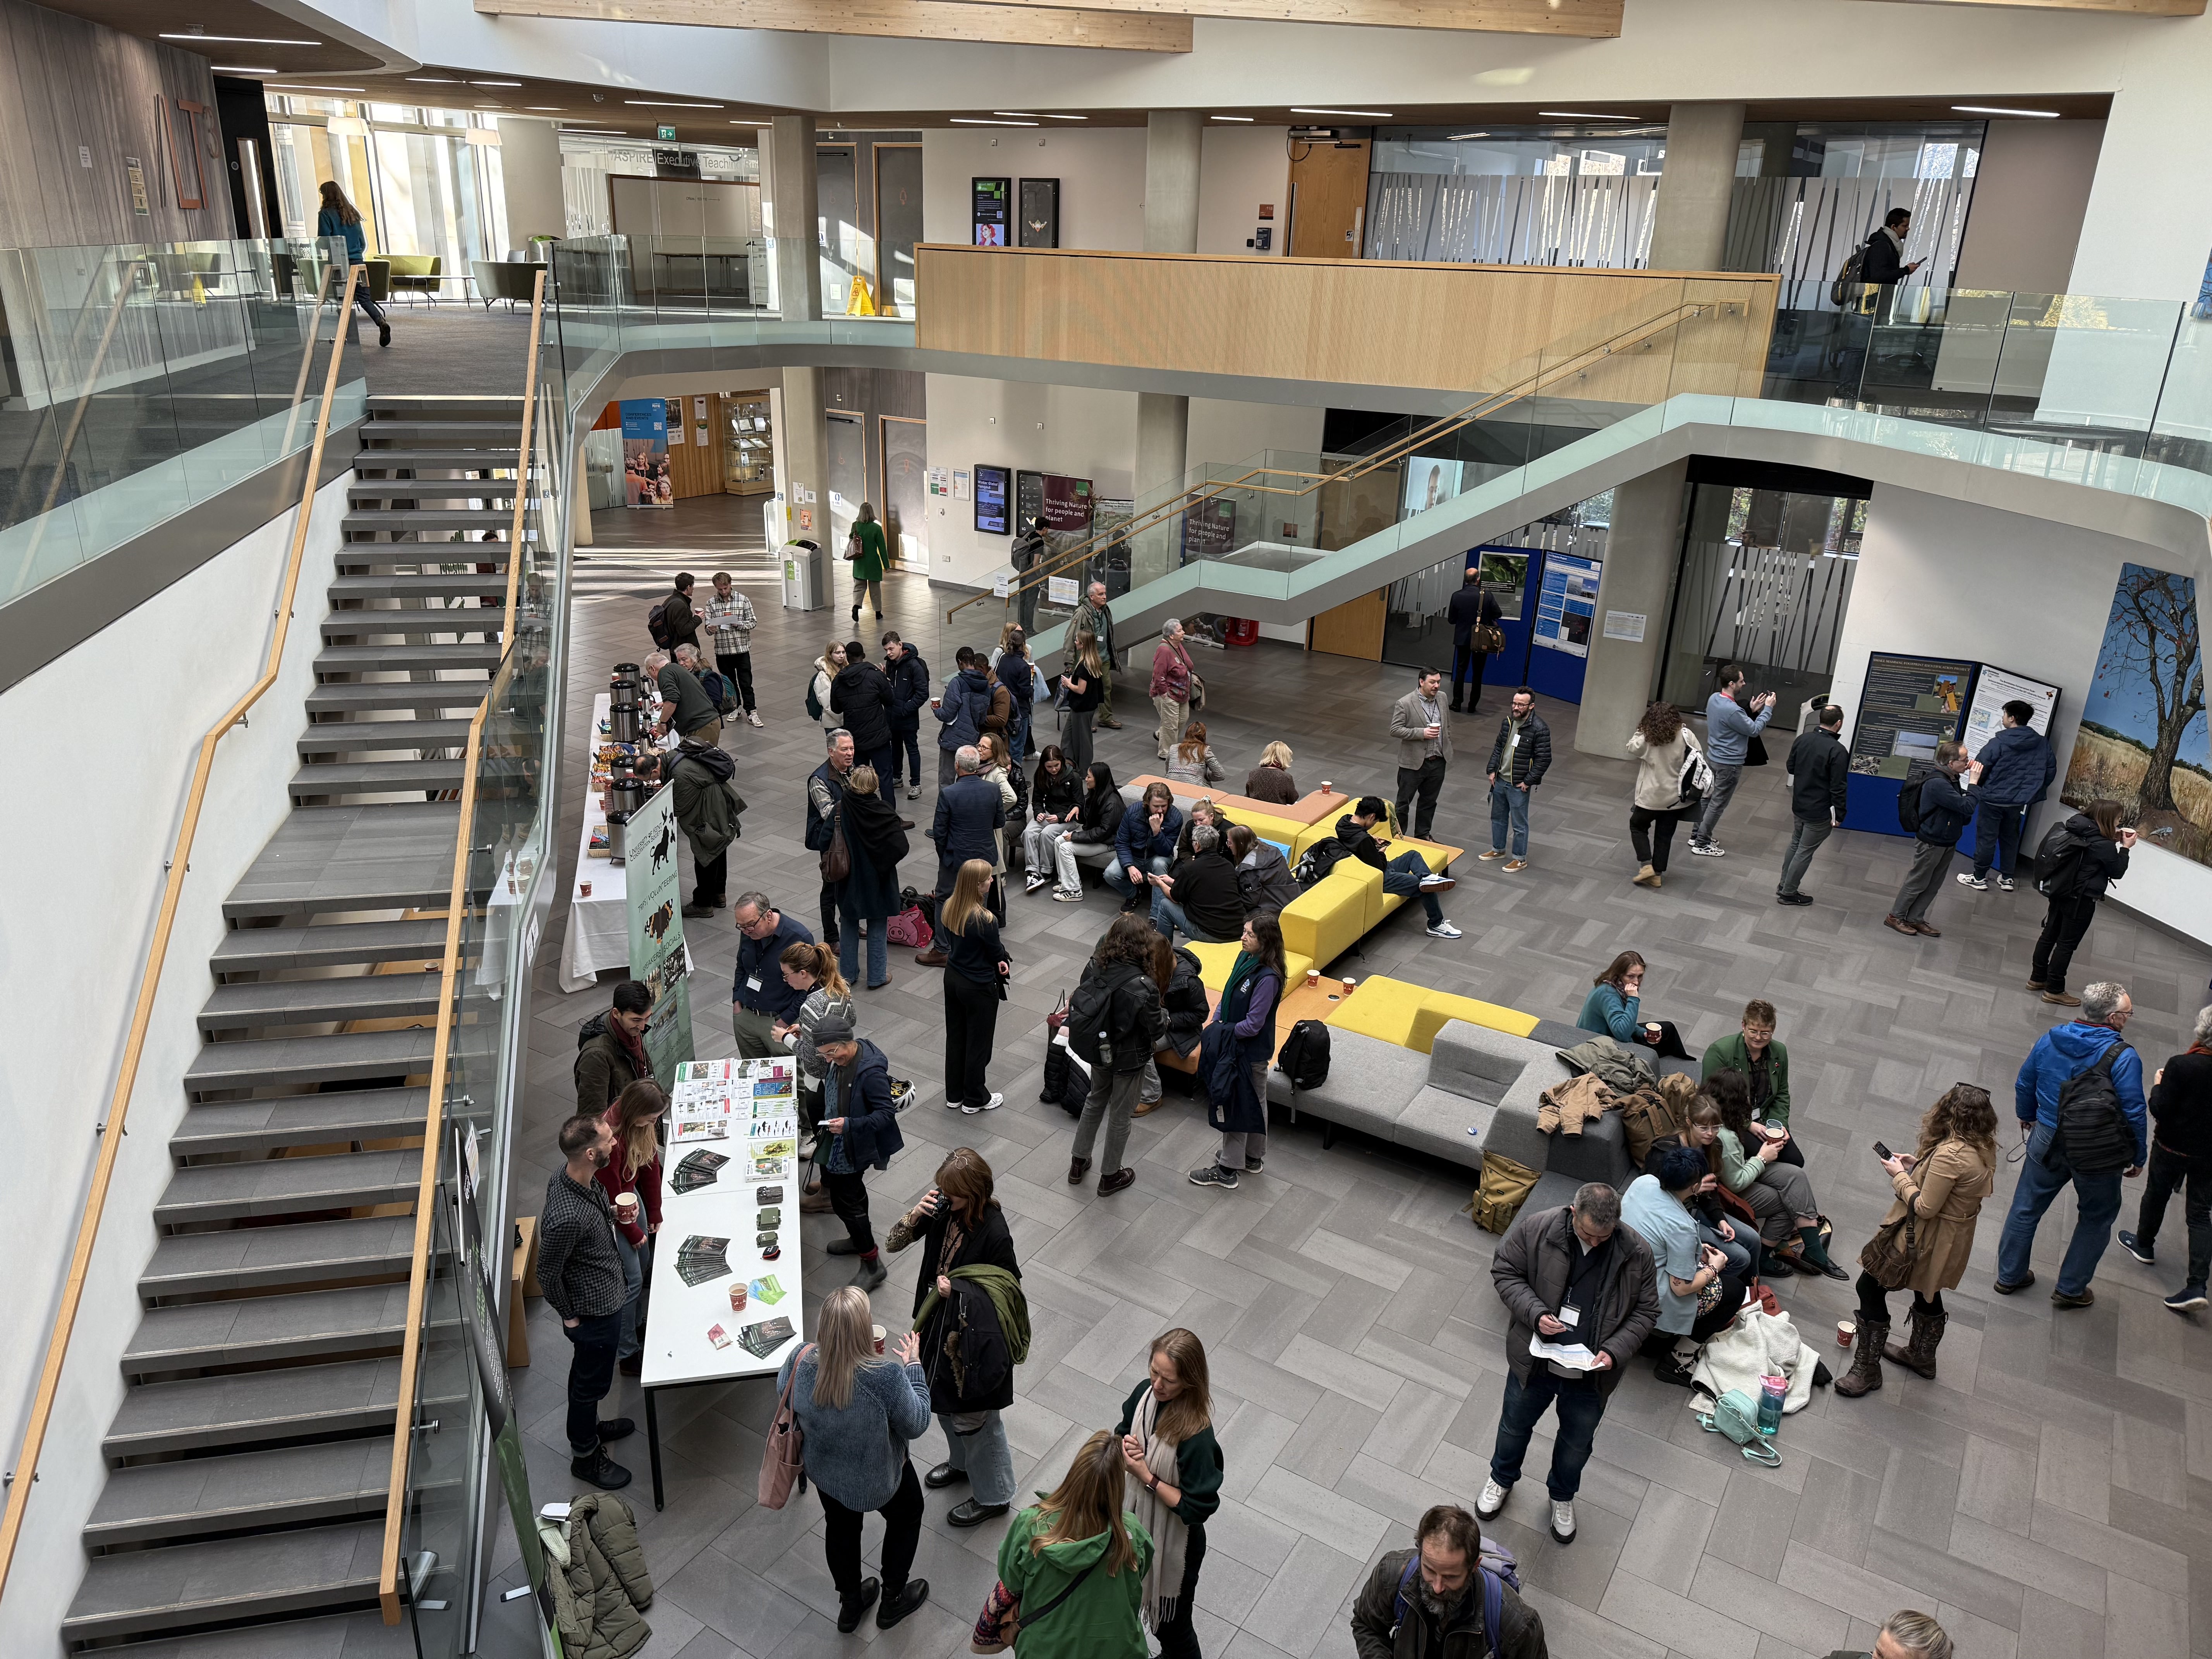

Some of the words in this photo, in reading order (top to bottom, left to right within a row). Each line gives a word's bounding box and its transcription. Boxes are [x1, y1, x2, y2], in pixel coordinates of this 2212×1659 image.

[657, 153, 700, 167] Executive
[1046, 498, 1068, 508] Thriving
[1189, 519, 1211, 529] Thriving
[1212, 523, 1230, 531] Nature
[1198, 530, 1215, 538] people
[629, 836, 647, 857] UNIVERSITY
[653, 822, 662, 833] KENT
[630, 840, 651, 861] CONSERVATION
[651, 830, 662, 842] SOCIETY
[638, 898, 647, 913] TRIPS
[648, 870, 678, 901] VOLUNTEERING
[643, 949, 661, 974] SPEAKERS
[663, 932, 681, 952] SOCIALS
